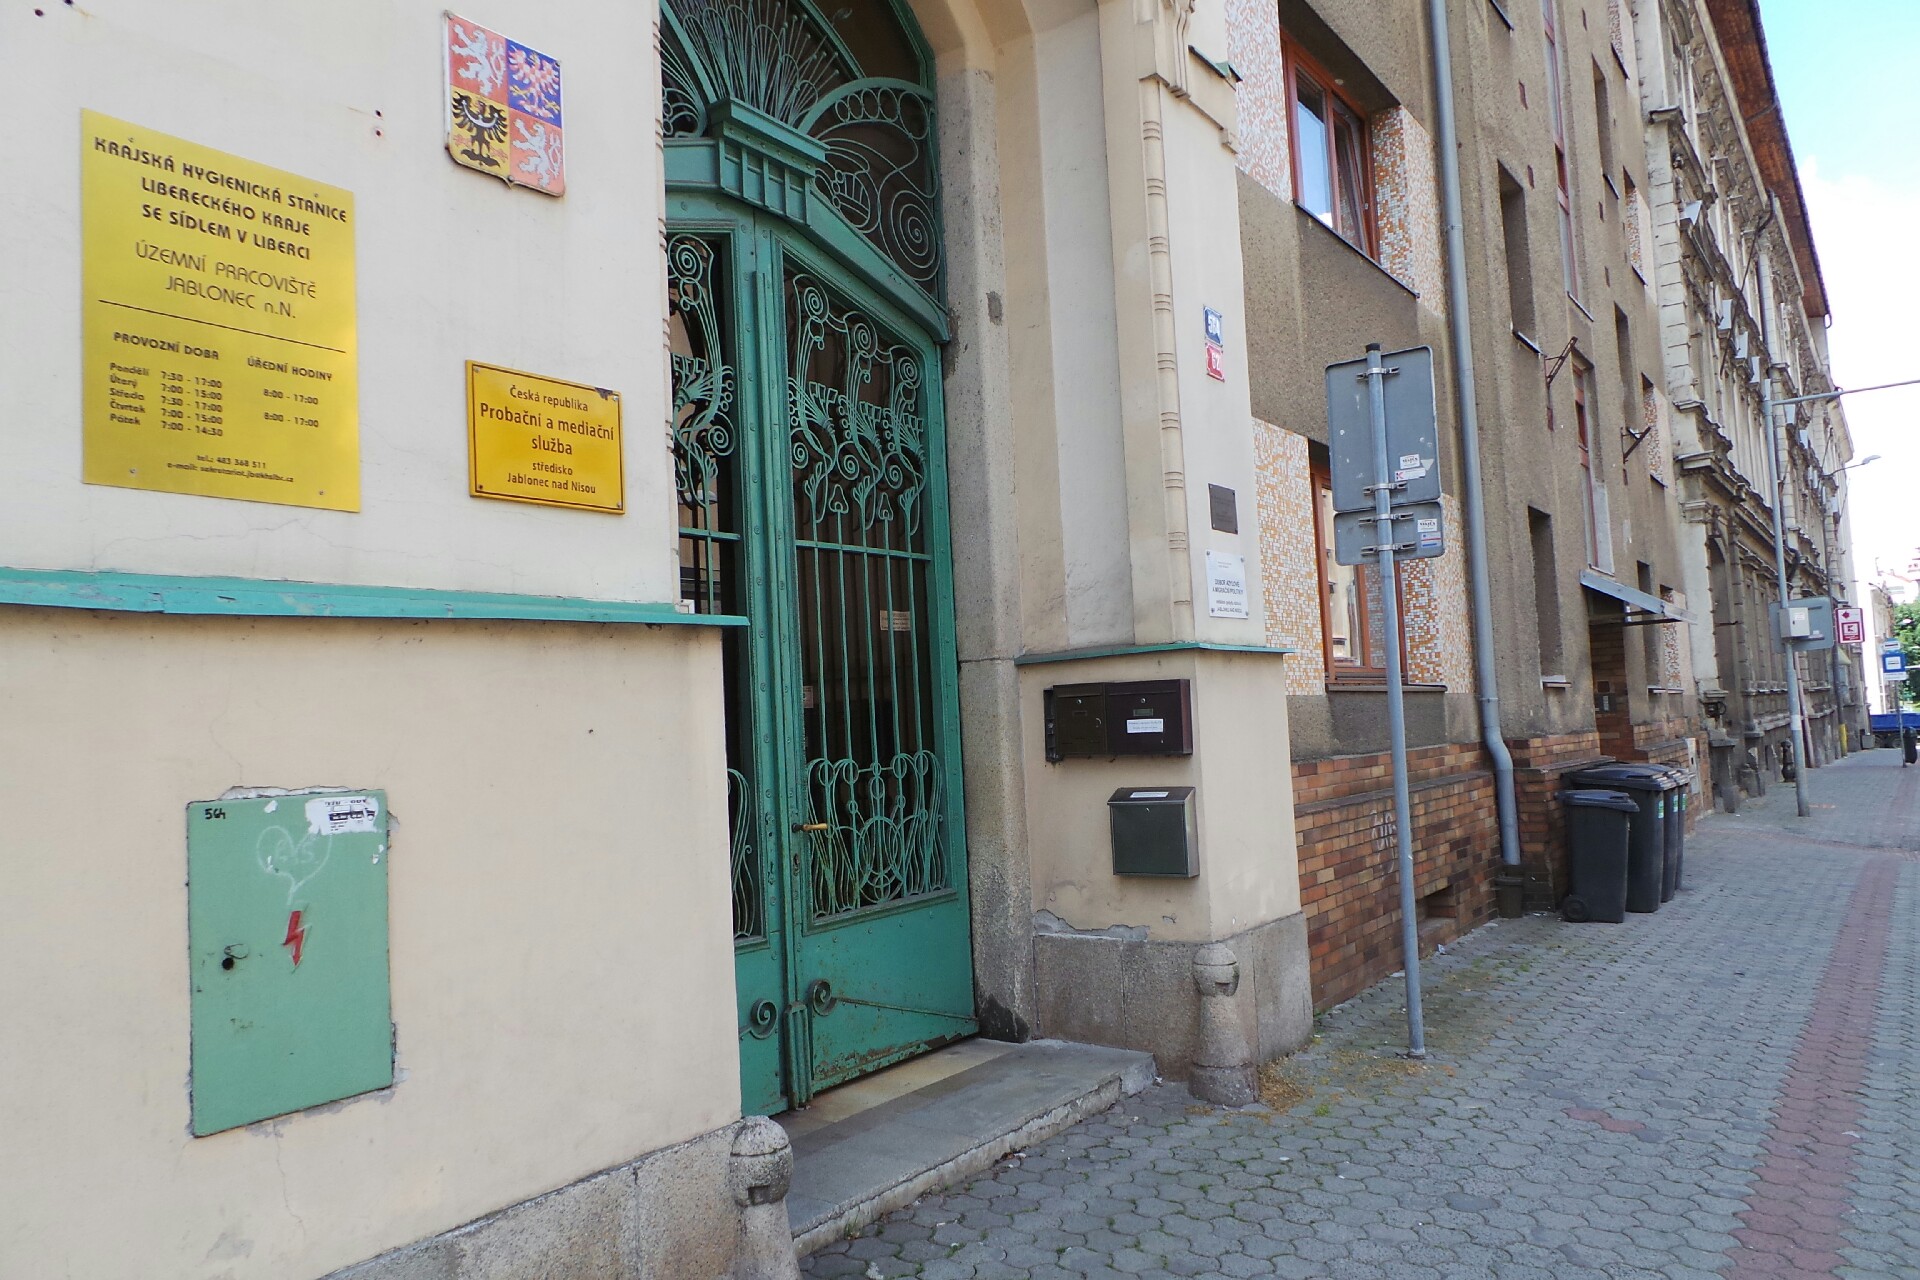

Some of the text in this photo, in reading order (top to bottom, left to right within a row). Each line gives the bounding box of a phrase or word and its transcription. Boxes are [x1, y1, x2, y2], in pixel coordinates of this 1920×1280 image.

[95, 137, 346, 222] KRAJSKÁ HYGIENICKÁ STANICE
[142, 177, 310, 236] LIBERECKÉHO KRAJE
[142, 204, 310, 260] SE SÍDLEM V LIBERCI
[136, 240, 316, 298] ÚZEMNÍ PRACOVIŠTĚ
[166, 276, 296, 318] JABLONEC n.N.
[114, 332, 219, 360] PROVOZNÍ DOBA
[110, 363, 149, 377] Pondělí
[161, 371, 183, 383] 7:30
[195, 377, 222, 388] 17:00
[248, 356, 332, 382] ÚŘEDNÍ HODINY
[109, 388, 144, 400] Středa
[161, 396, 183, 407] 7:30
[196, 401, 222, 413] 17:00
[110, 374, 138, 388] Úterý
[161, 383, 183, 395] 7:00
[195, 389, 222, 401] 15:00
[264, 389, 283, 400] 8:00
[294, 394, 318, 405] 17:00
[510, 385, 588, 412] Česká republika
[110, 399, 146, 413] Čtvrtek
[161, 408, 183, 419] 7:00
[196, 413, 222, 425] 15:00
[110, 412, 140, 425] Pátek
[161, 420, 184, 431] 7:00
[196, 426, 223, 437] 14:30
[264, 412, 284, 422] 8:00
[294, 417, 319, 427] 17:00
[480, 403, 614, 440] Probační a mediační
[532, 435, 572, 455] služba
[252, 460, 266, 469] 511
[532, 462, 573, 476] středisko
[508, 473, 596, 493] Jablonec nad Nisou
[205, 808, 226, 819] 564
